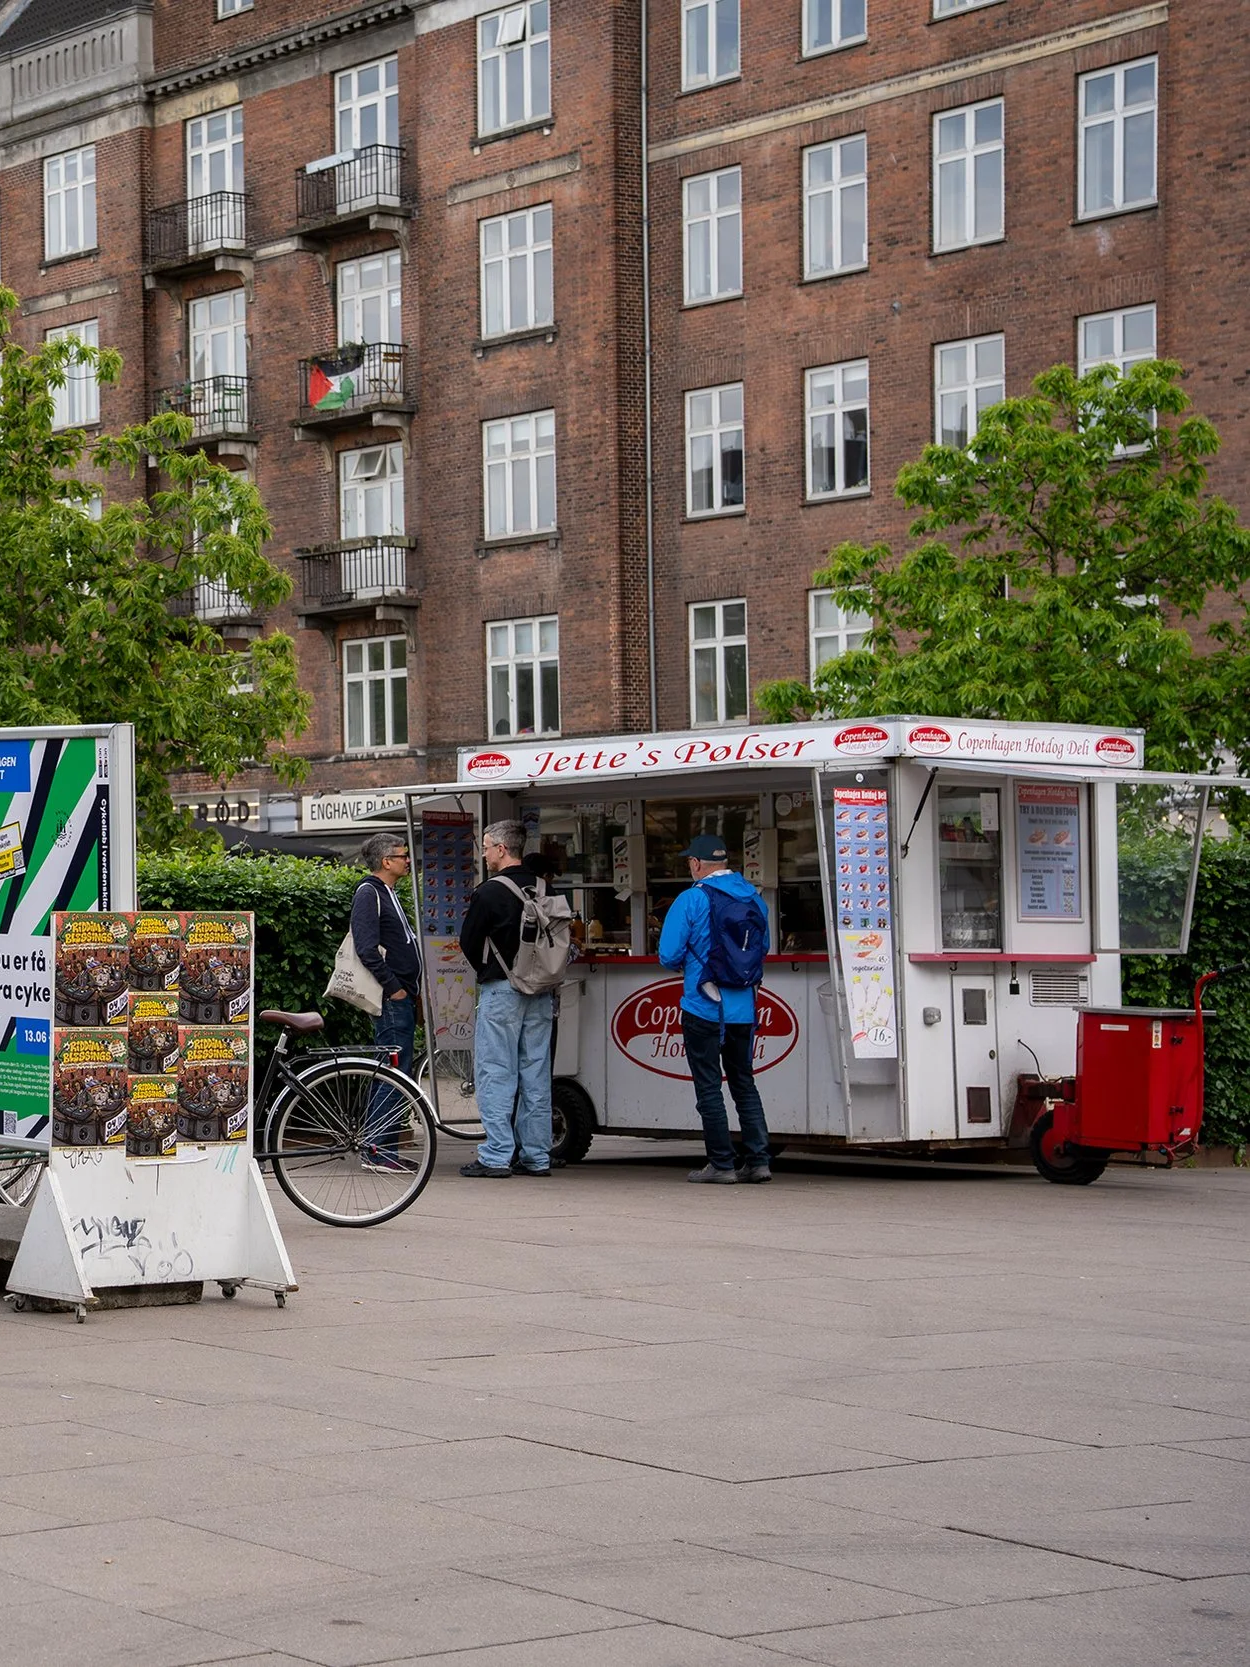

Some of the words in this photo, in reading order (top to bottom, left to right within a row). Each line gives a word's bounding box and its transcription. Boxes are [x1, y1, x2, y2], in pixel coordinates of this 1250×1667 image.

[839, 730, 883, 744] Copenhagen
[912, 730, 947, 743] Copenhagen
[957, 732, 1021, 756] Copenhagen
[1024, 736, 1064, 759] Hotdog
[1067, 739, 1090, 755] Deli
[1098, 740, 1131, 752] Copenhagen
[471, 756, 507, 768] Copenhagen
[527, 742, 662, 778] Jette's
[674, 734, 815, 764] Pølser
[834, 789, 861, 800] Copenhagen
[311, 801, 362, 820] ENGHAVE
[13, 955, 28, 970] er
[31, 949, 46, 971] få
[852, 965, 885, 973] vegetarian
[25, 1029, 47, 1043] 13.06
[873, 1028, 891, 1042] 16,-
